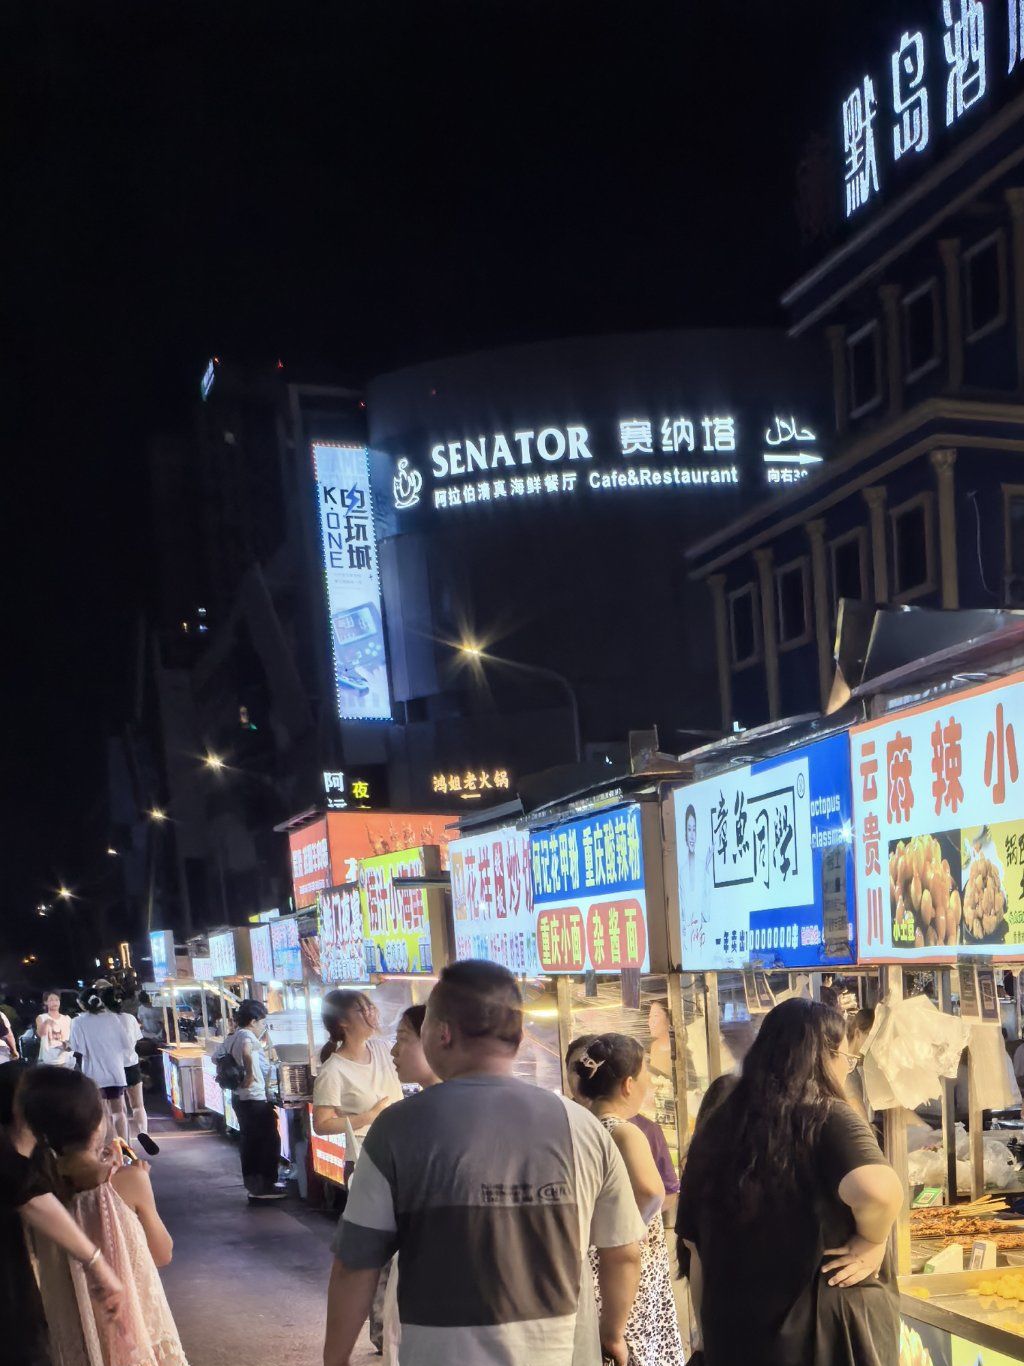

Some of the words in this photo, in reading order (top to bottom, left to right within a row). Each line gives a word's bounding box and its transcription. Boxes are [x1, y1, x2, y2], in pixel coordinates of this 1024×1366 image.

[431, 426, 592, 478] SENATOR
[619, 416, 736, 455] 赛纳塔
[434, 472, 577, 509] 阿拉伯清真海鲜餐厅
[588, 467, 738, 489] Cafe&Restaurant
[810, 791, 841, 819] octopus
[811, 824, 855, 850] classma
[859, 740, 885, 946] 云贵川
[540, 914, 583, 965] 重庆小面
